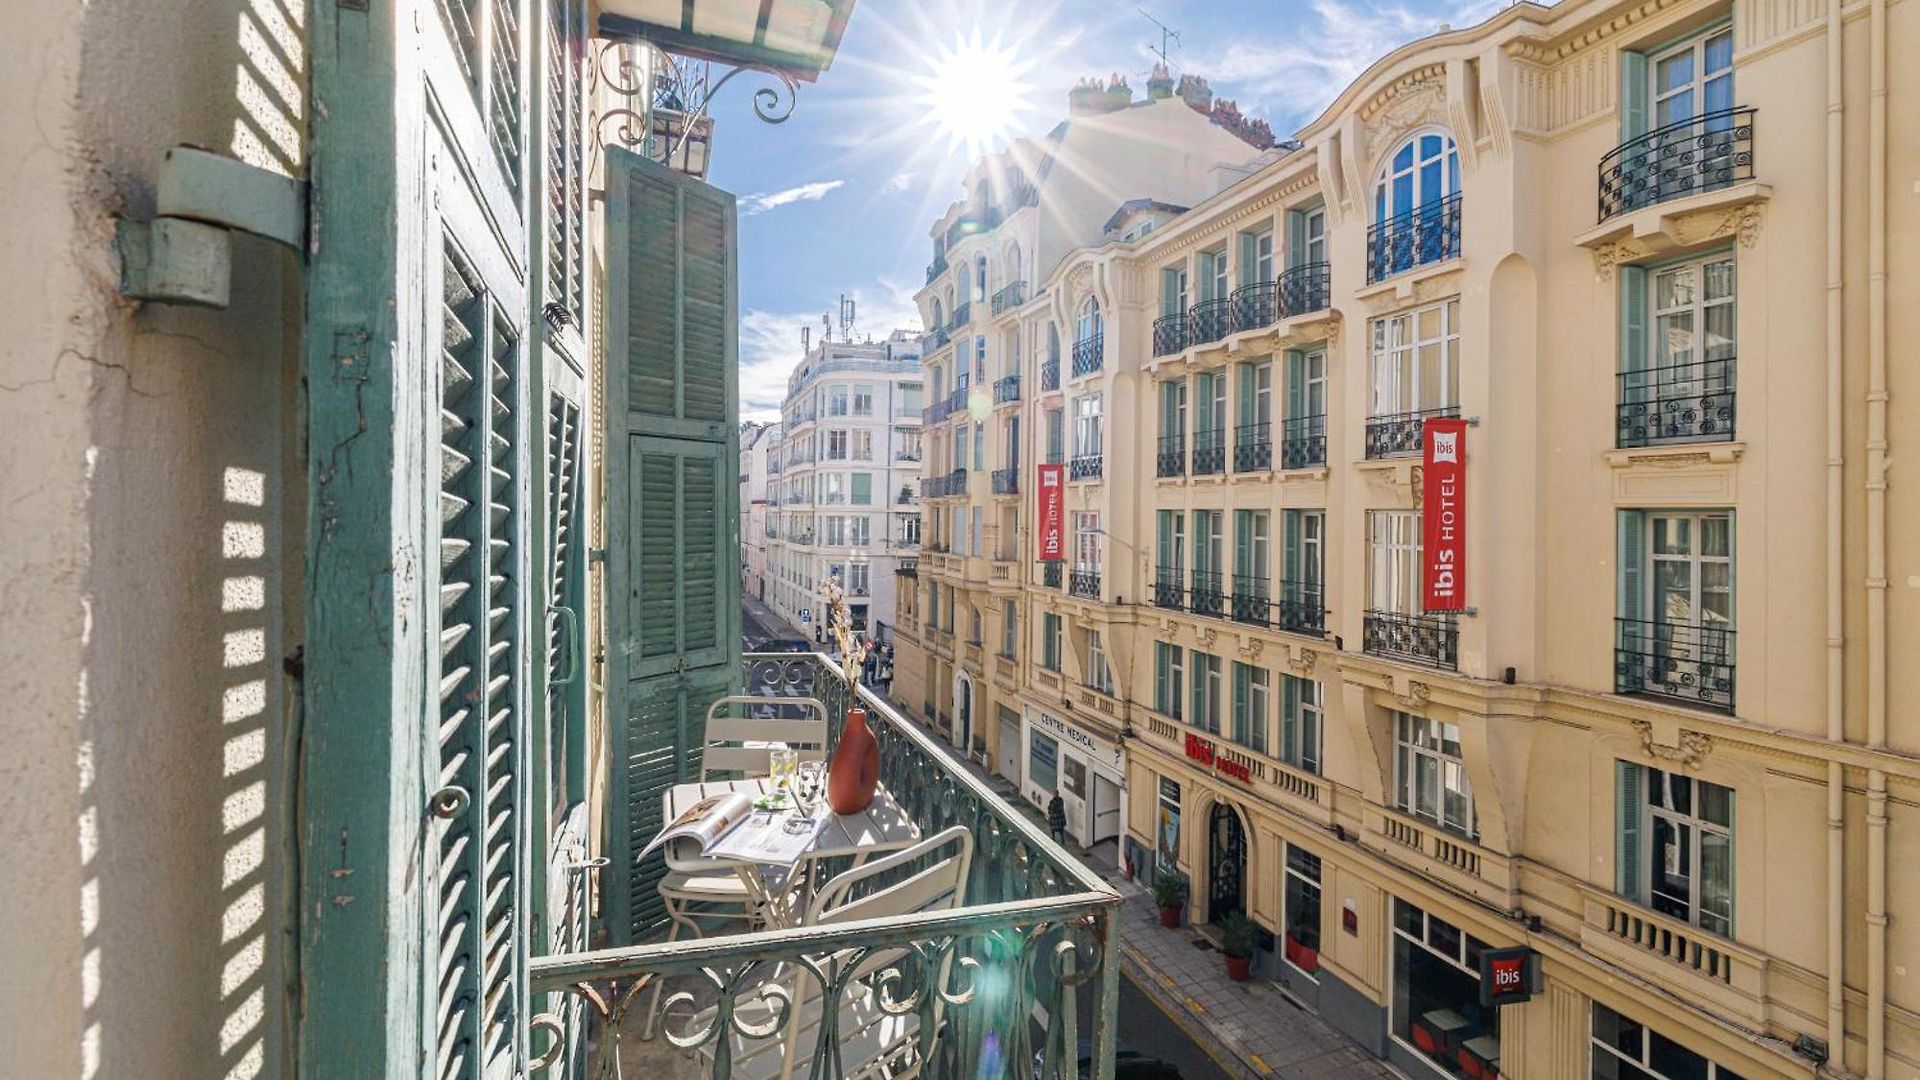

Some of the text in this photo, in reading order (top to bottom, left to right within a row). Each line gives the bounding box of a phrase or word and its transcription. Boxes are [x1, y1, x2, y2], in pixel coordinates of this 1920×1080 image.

[1436, 441, 1454, 454] ibis
[1046, 528, 1058, 554] ibis
[1434, 474, 1455, 597] ibis HOTEL
[1041, 713, 1065, 734] CENTRE
[1496, 968, 1520, 985] ibis
